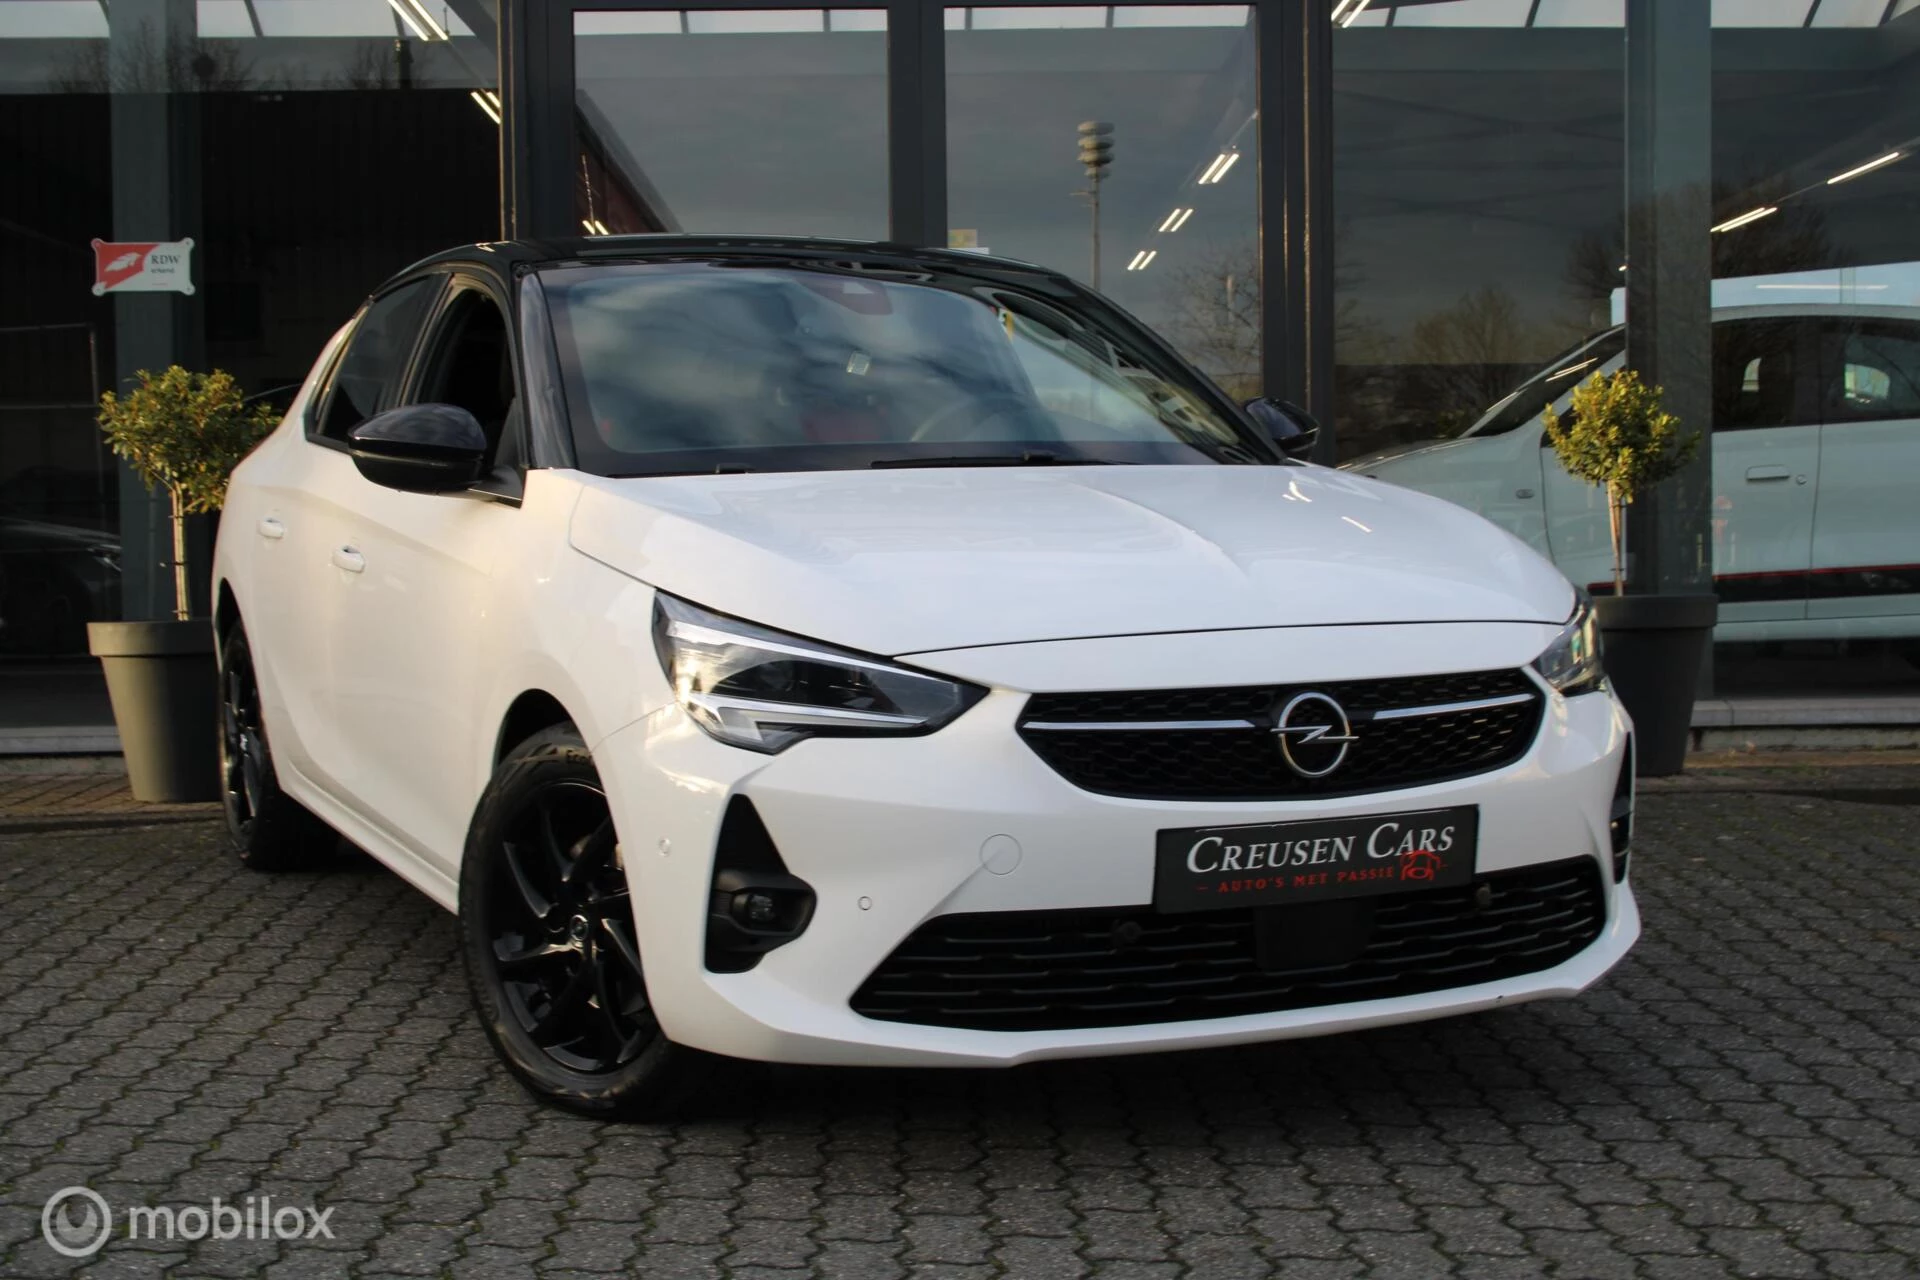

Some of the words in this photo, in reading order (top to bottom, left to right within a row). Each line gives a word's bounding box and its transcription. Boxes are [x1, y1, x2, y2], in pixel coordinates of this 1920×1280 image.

[151, 254, 180, 265] RDW
[1218, 877, 1284, 893] AUTO'S
[1295, 871, 1328, 886] MET
[1336, 866, 1396, 883] PASSIE
